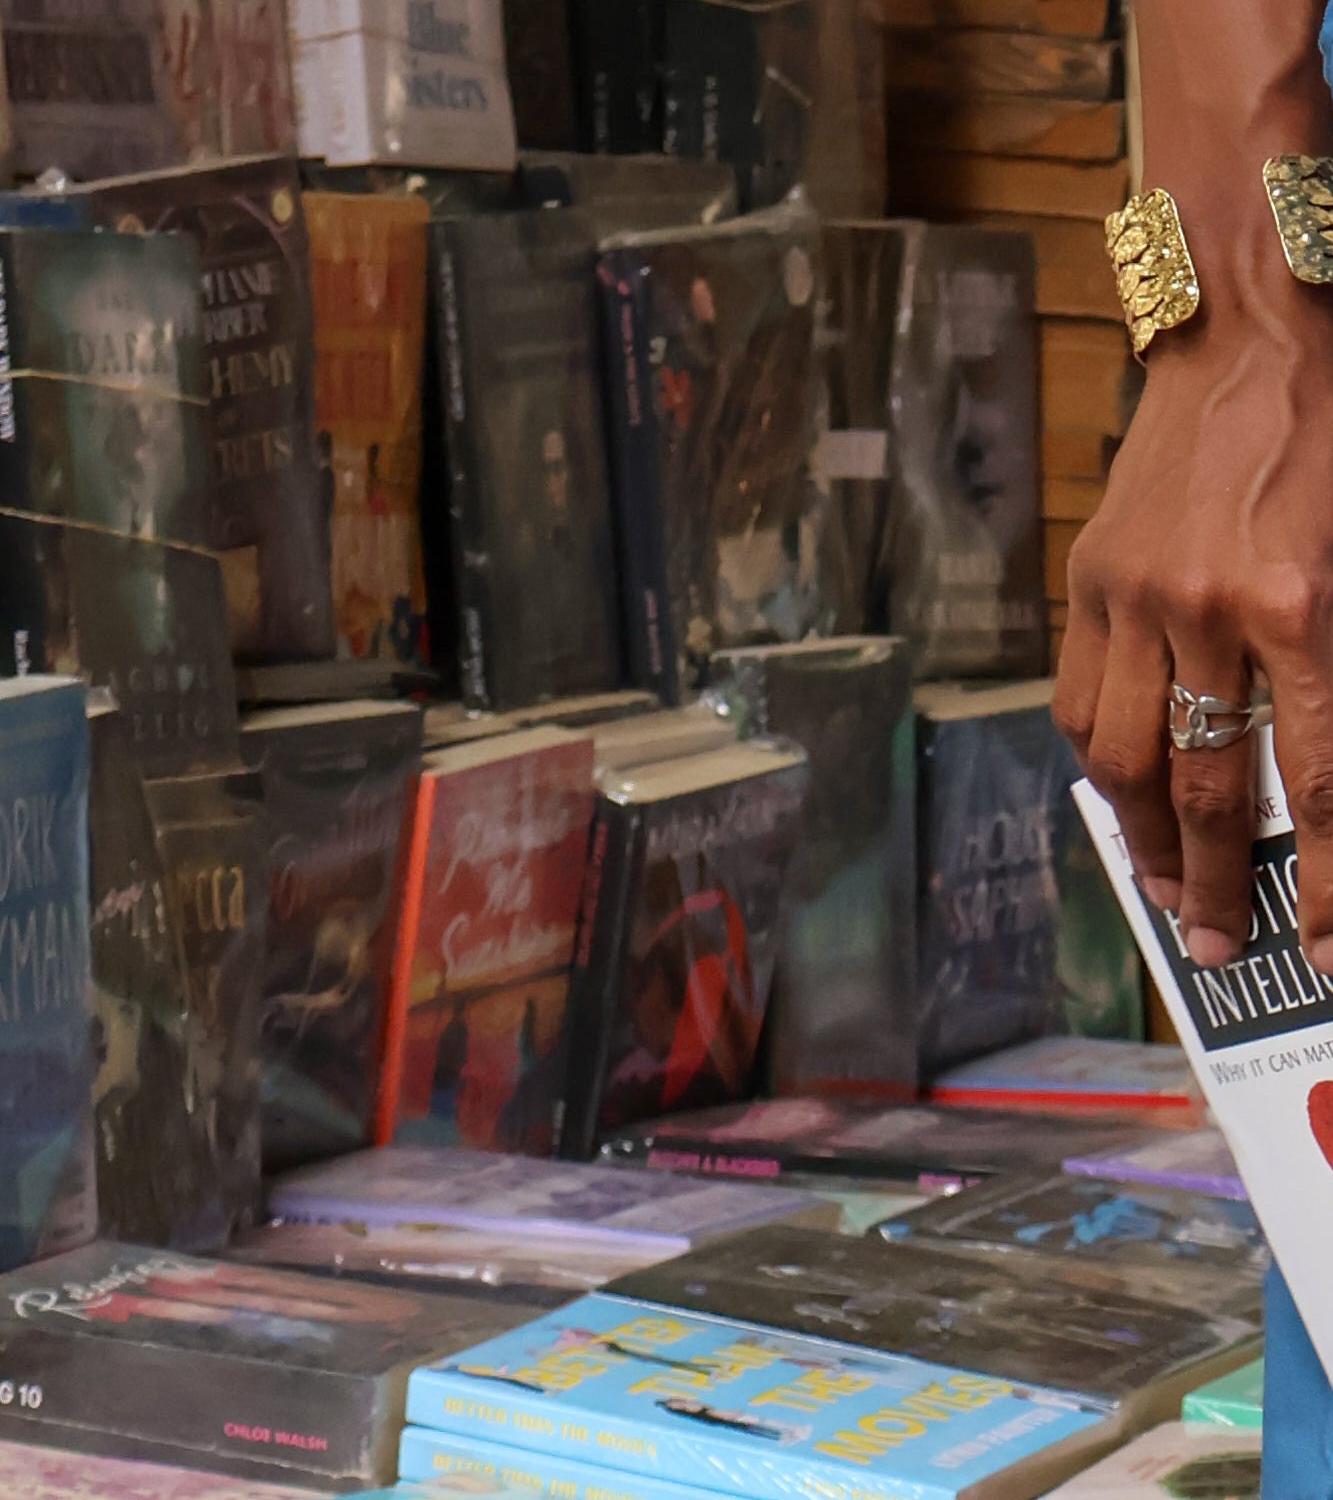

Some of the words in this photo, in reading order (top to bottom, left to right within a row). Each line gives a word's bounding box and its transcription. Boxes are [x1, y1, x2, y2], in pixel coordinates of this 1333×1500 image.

[1255, 796, 1282, 826] NE
[1249, 1058, 1265, 1075] IT
[1268, 1049, 1301, 1074] CAN
[18, 1383, 43, 1409] 10
[813, 1375, 1013, 1465] MOVIES
